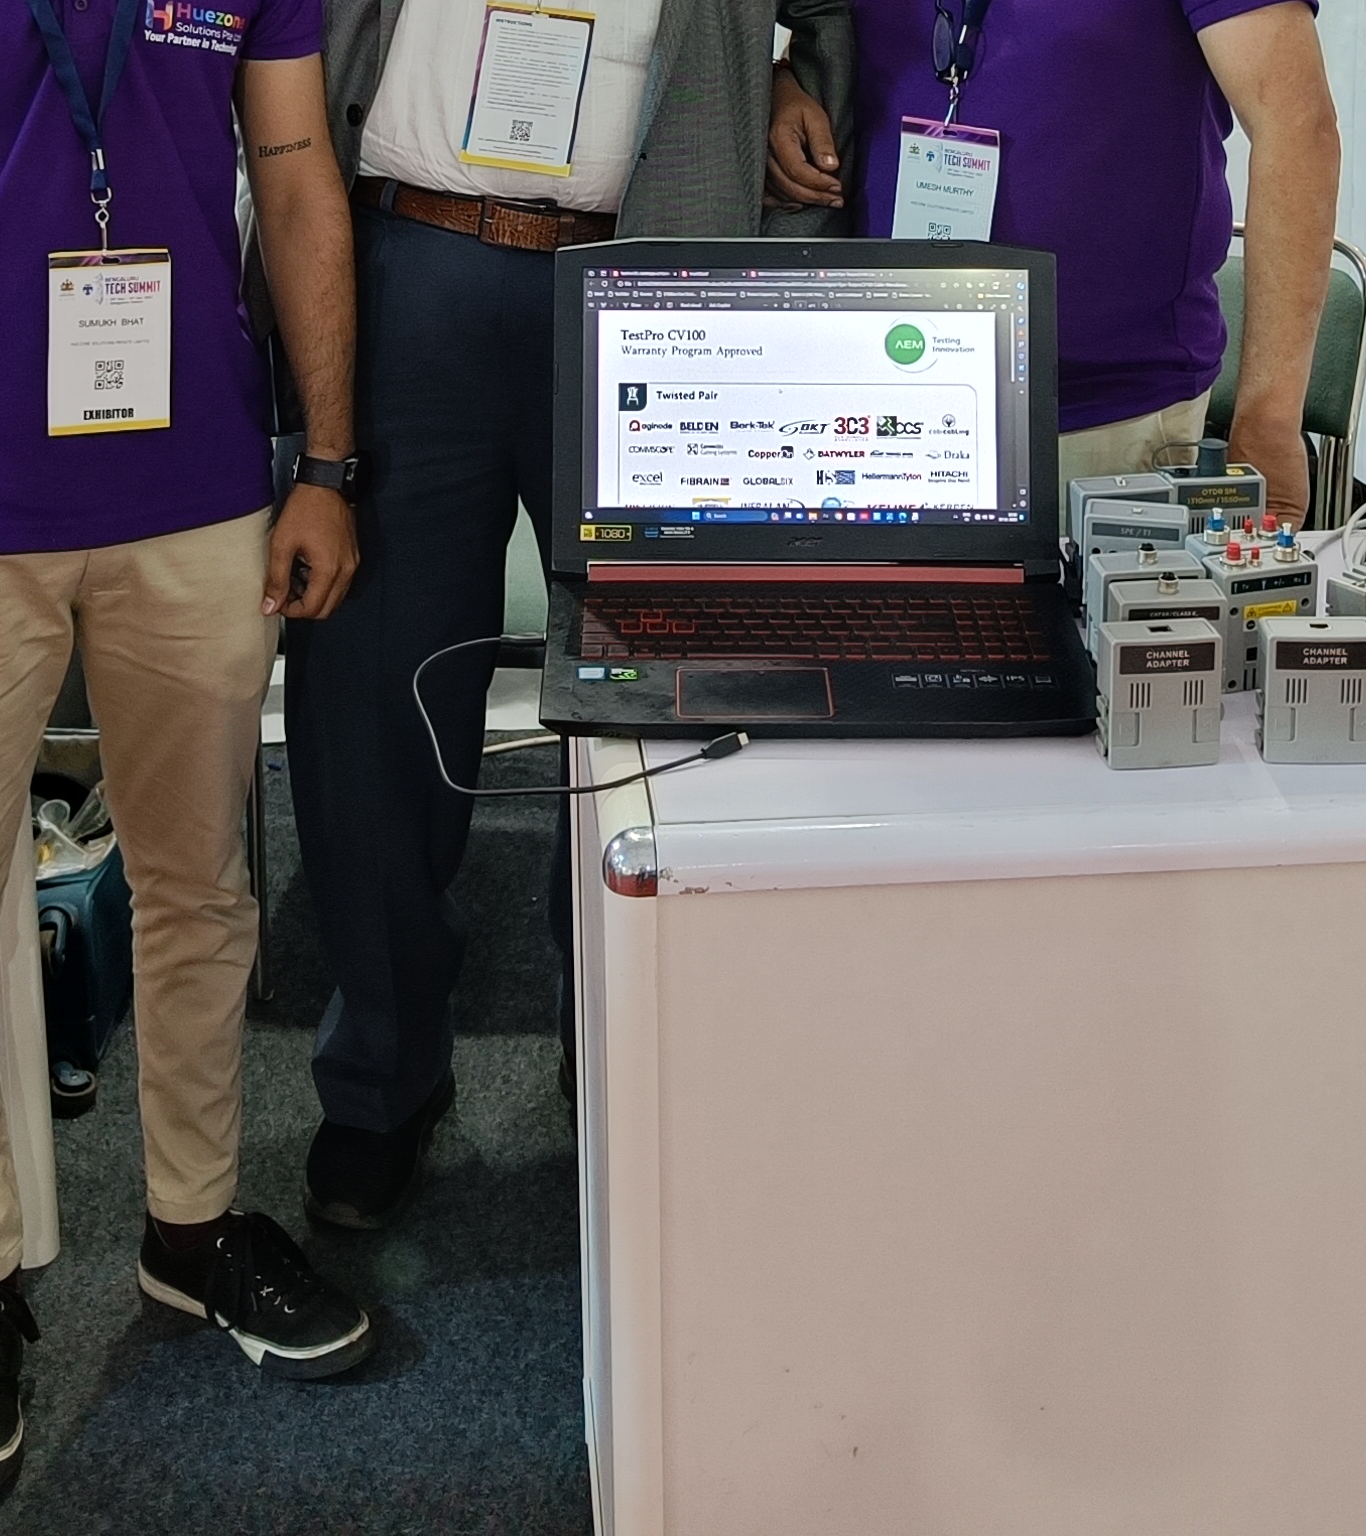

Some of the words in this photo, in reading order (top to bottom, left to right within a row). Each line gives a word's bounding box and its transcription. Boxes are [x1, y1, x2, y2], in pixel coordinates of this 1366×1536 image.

[176, 22, 221, 39] Solutions
[144, 30, 166, 43] Your
[167, 33, 201, 48] Partner
[916, 181, 942, 192] UMESH
[943, 186, 975, 197] MURTHY
[105, 283, 126, 295] TECH
[128, 280, 161, 294] SUMMIT
[78, 318, 117, 328] SUMUKH
[121, 317, 145, 327] BHAT
[620, 329, 664, 342] TestPro
[667, 329, 707, 342] CV100
[621, 346, 668, 358] Warranty
[671, 346, 712, 358] Program
[716, 346, 763, 358] Approved
[656, 390, 696, 401] Twisted
[698, 390, 718, 401] Pair
[83, 408, 135, 421] EXHIBITOR
[680, 421, 719, 431] BELDEN
[944, 450, 970, 460] Draka
[632, 471, 663, 483] excel
[929, 470, 969, 478] HITACHI
[1146, 650, 1190, 660] CHANNEL
[1302, 648, 1348, 657] CHANNEL
[1146, 659, 1190, 669] ADAPTER
[1302, 656, 1348, 666] ADAPTER
